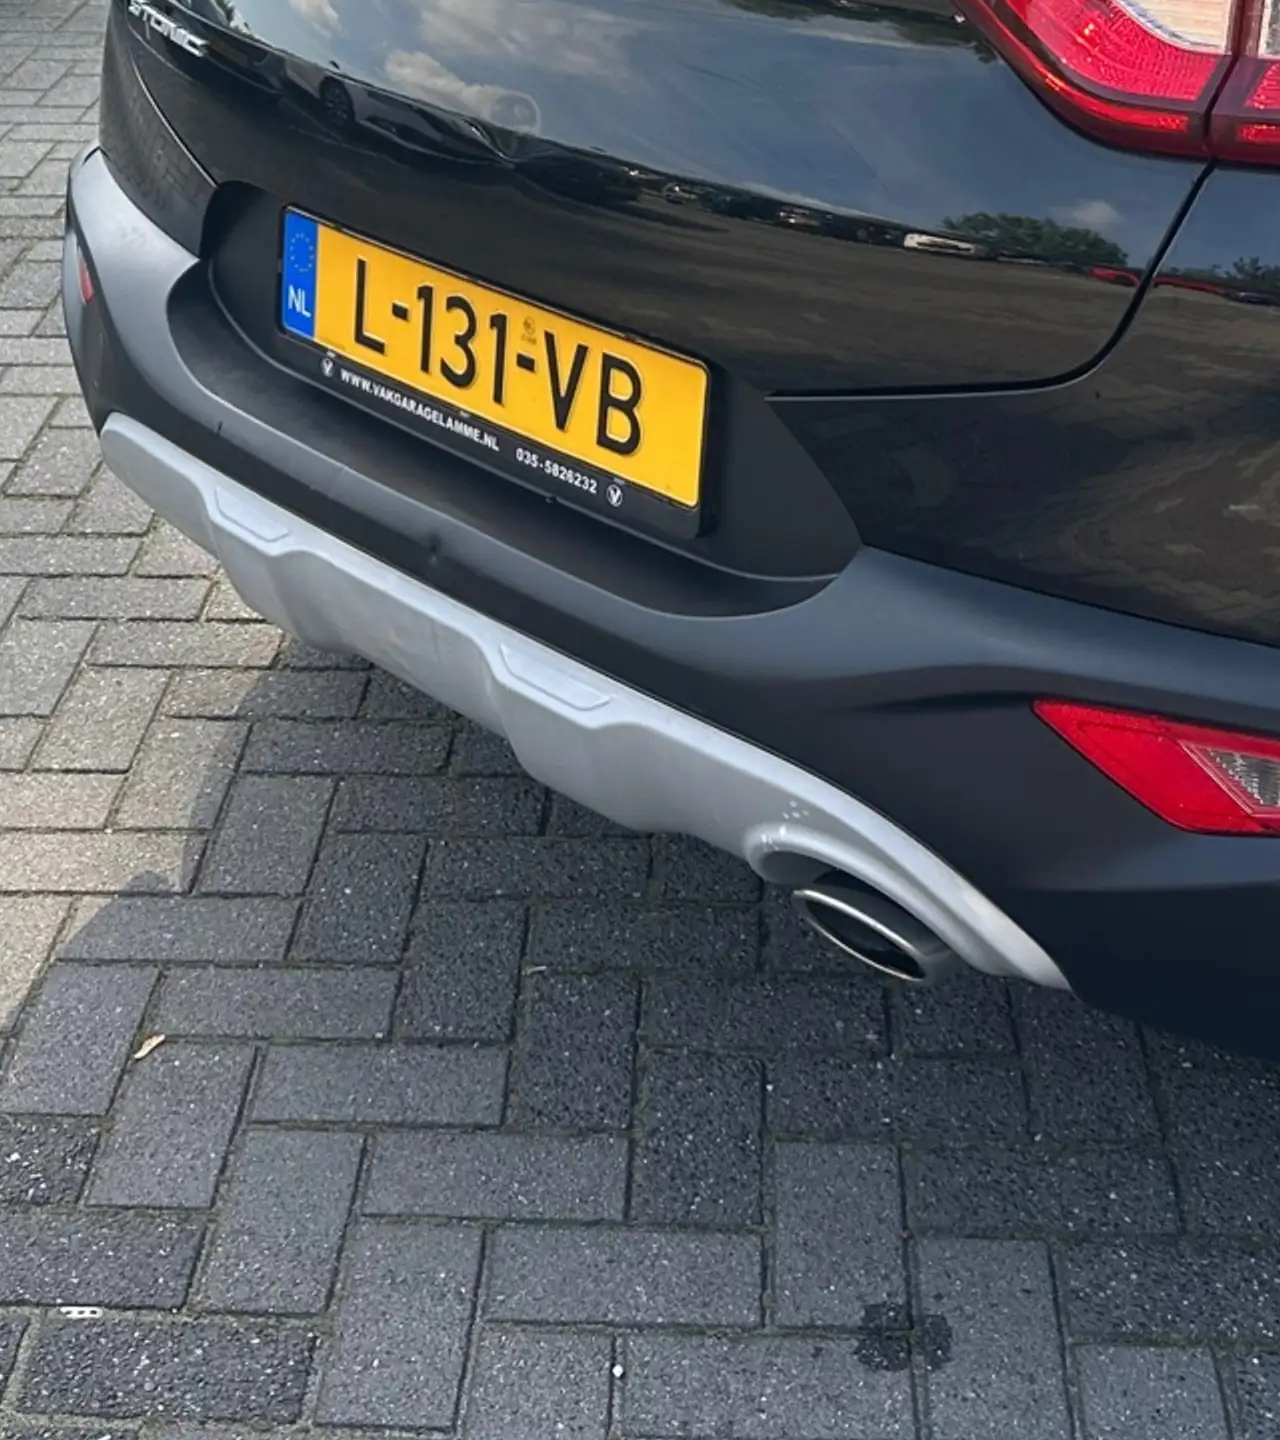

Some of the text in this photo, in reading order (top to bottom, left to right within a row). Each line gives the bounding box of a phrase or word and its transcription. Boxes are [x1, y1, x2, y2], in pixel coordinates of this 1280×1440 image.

[287, 257, 644, 457] NL L-131-VB
[339, 367, 501, 453] WWW.VAKGARAGELAMME.NL
